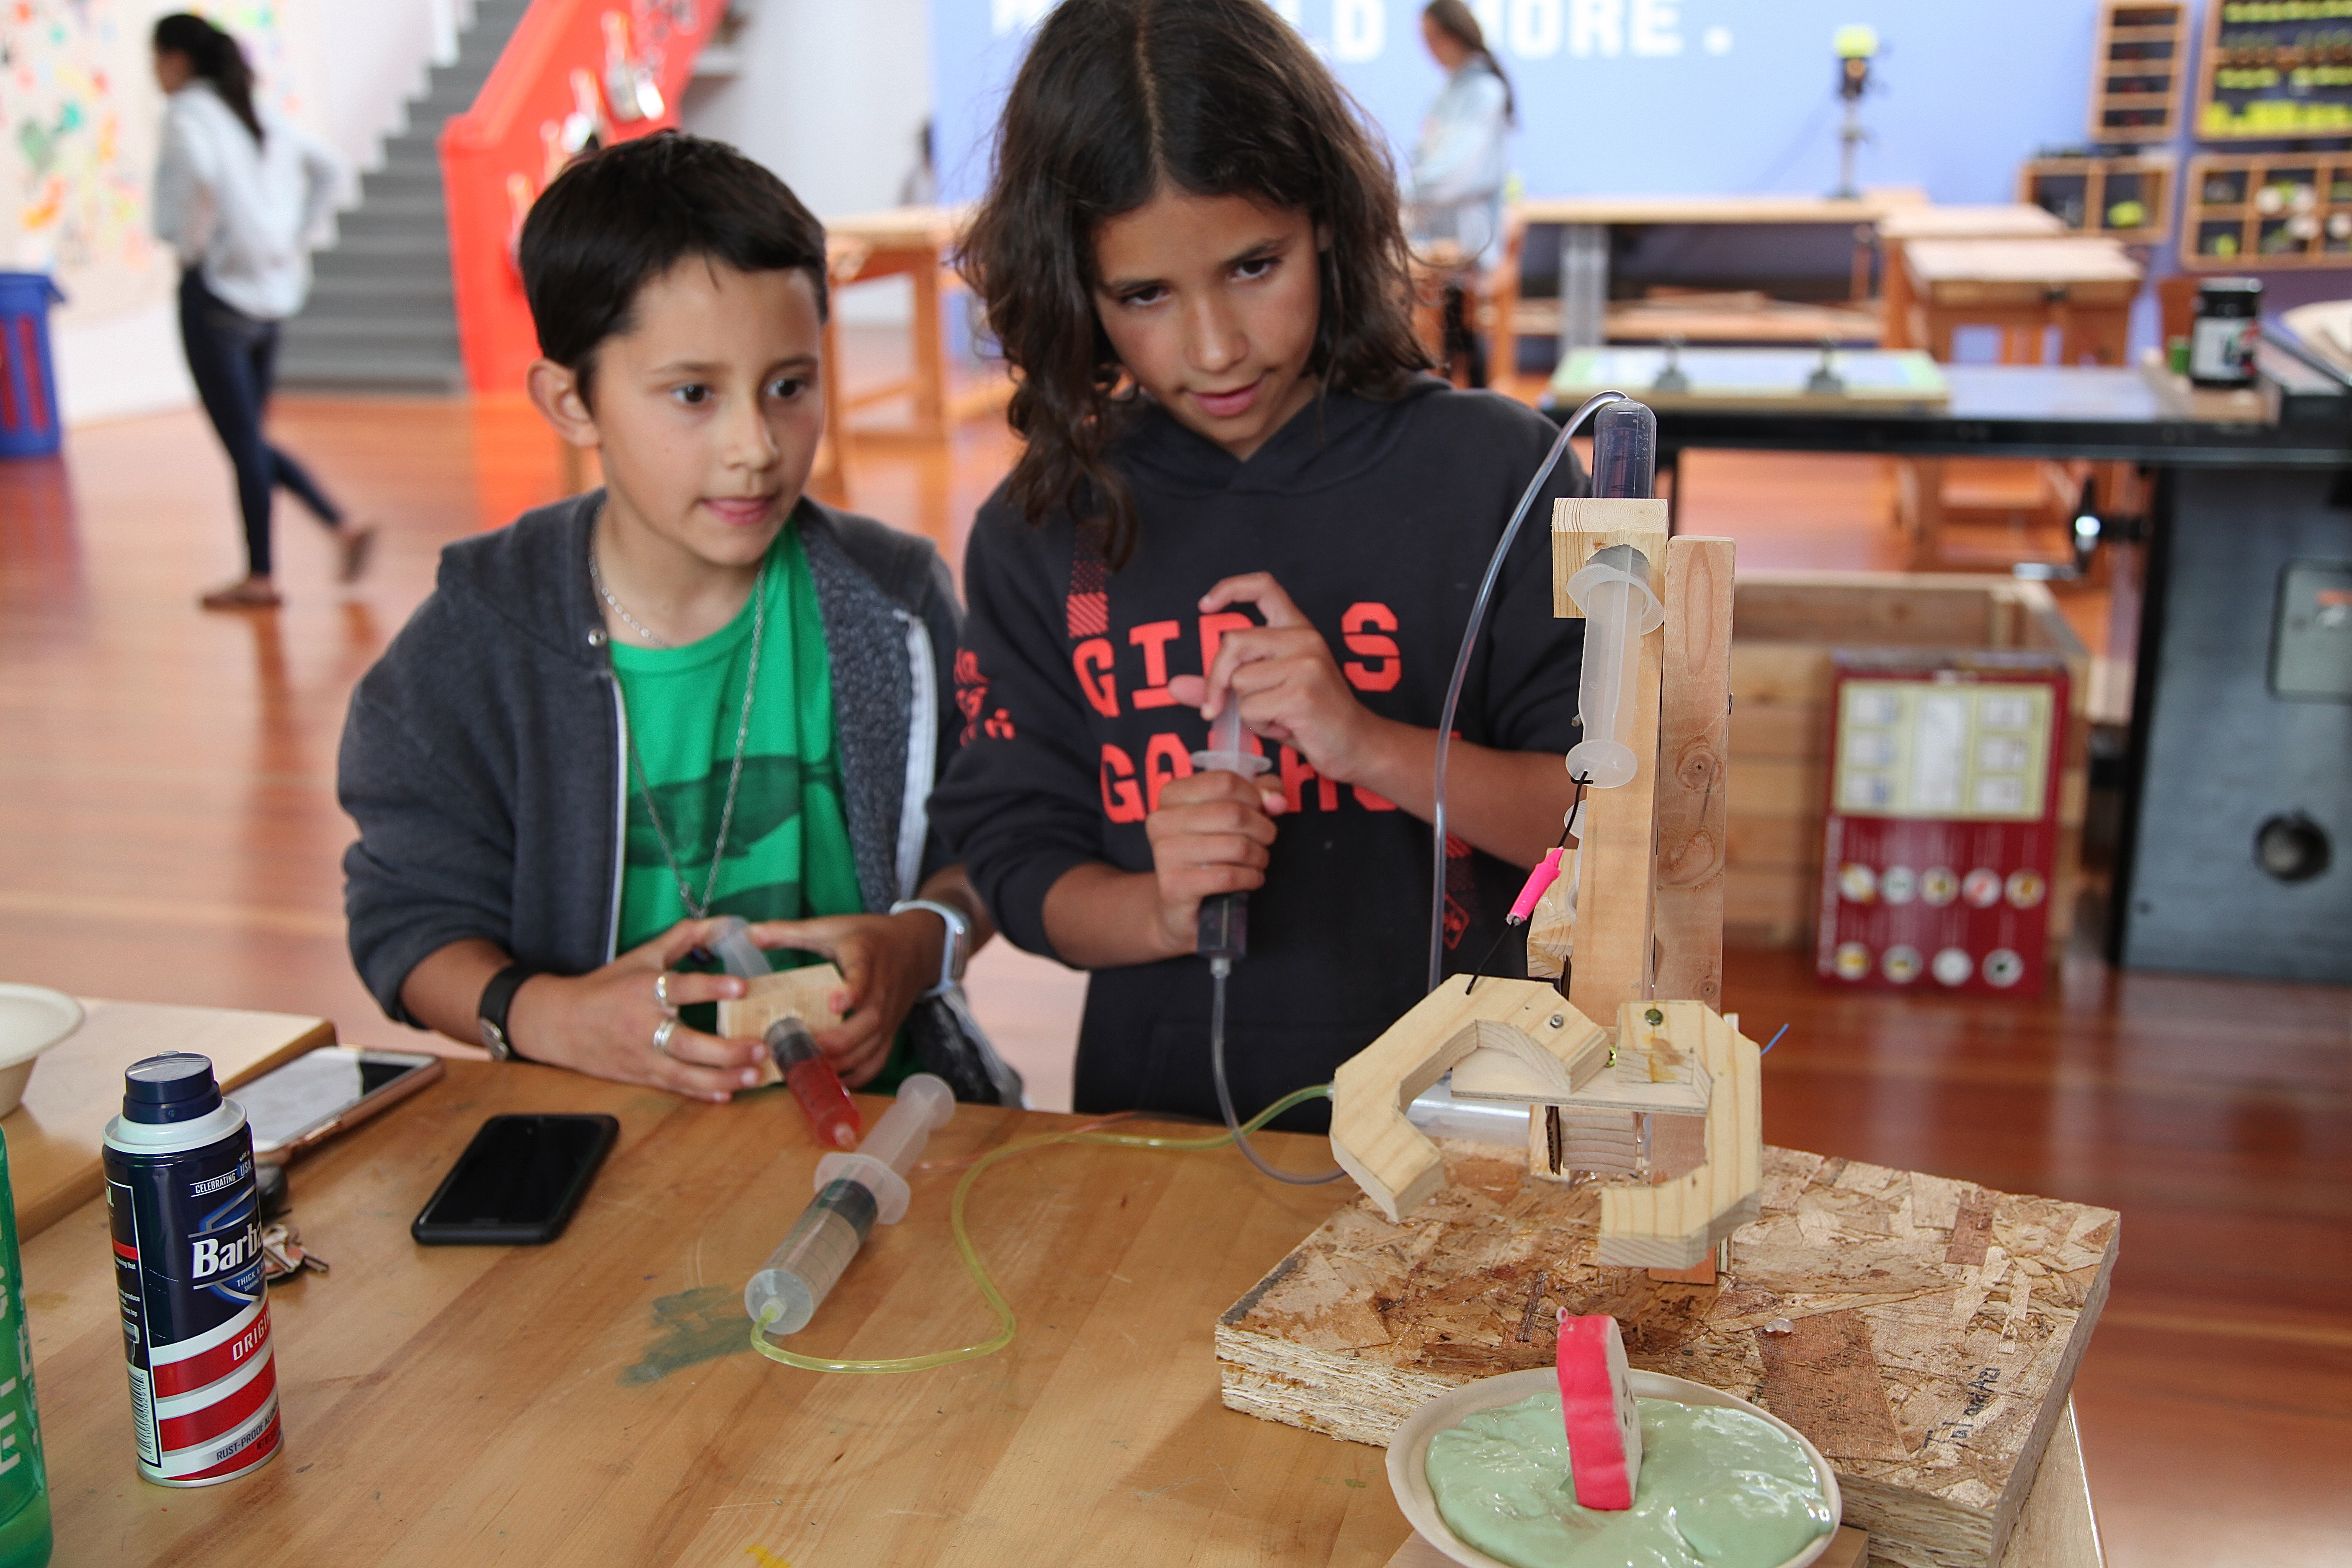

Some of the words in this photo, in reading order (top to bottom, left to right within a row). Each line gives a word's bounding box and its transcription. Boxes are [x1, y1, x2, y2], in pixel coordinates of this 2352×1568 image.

[1479, 0, 1733, 59] ORE.
[1073, 601, 1402, 718] GIS
[240, 1159, 252, 1176] USA
[195, 1172, 236, 1194] CELEBRATING
[236, 1271, 256, 1287] THICK
[216, 1421, 263, 1460] RUST-PROOF
